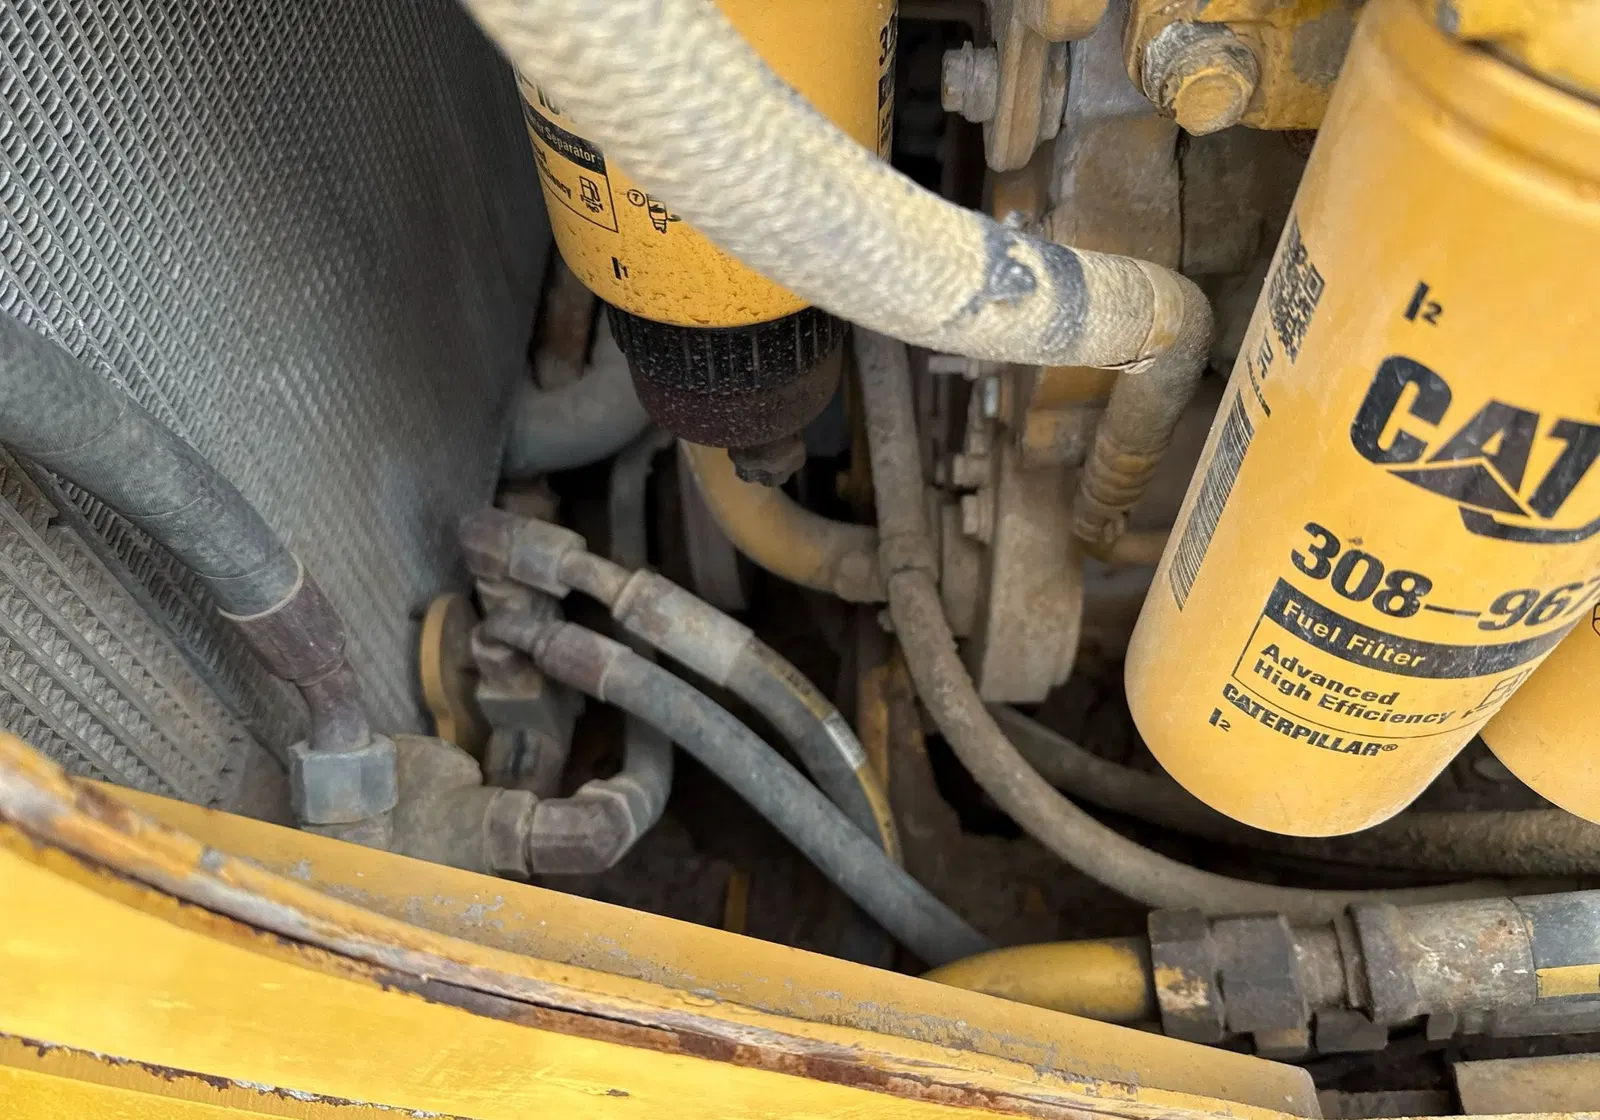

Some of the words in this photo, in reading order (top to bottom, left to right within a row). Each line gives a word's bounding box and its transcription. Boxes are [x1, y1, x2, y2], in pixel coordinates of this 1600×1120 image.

[545, 126, 596, 163] Separator
[1350, 355, 1600, 520] CAT
[1283, 600, 1341, 643] Fuel
[1347, 633, 1427, 669] Filter
[1253, 658, 1313, 701] High
[1317, 692, 1456, 725] Efficiency
[1260, 643, 1401, 706] Advanced
